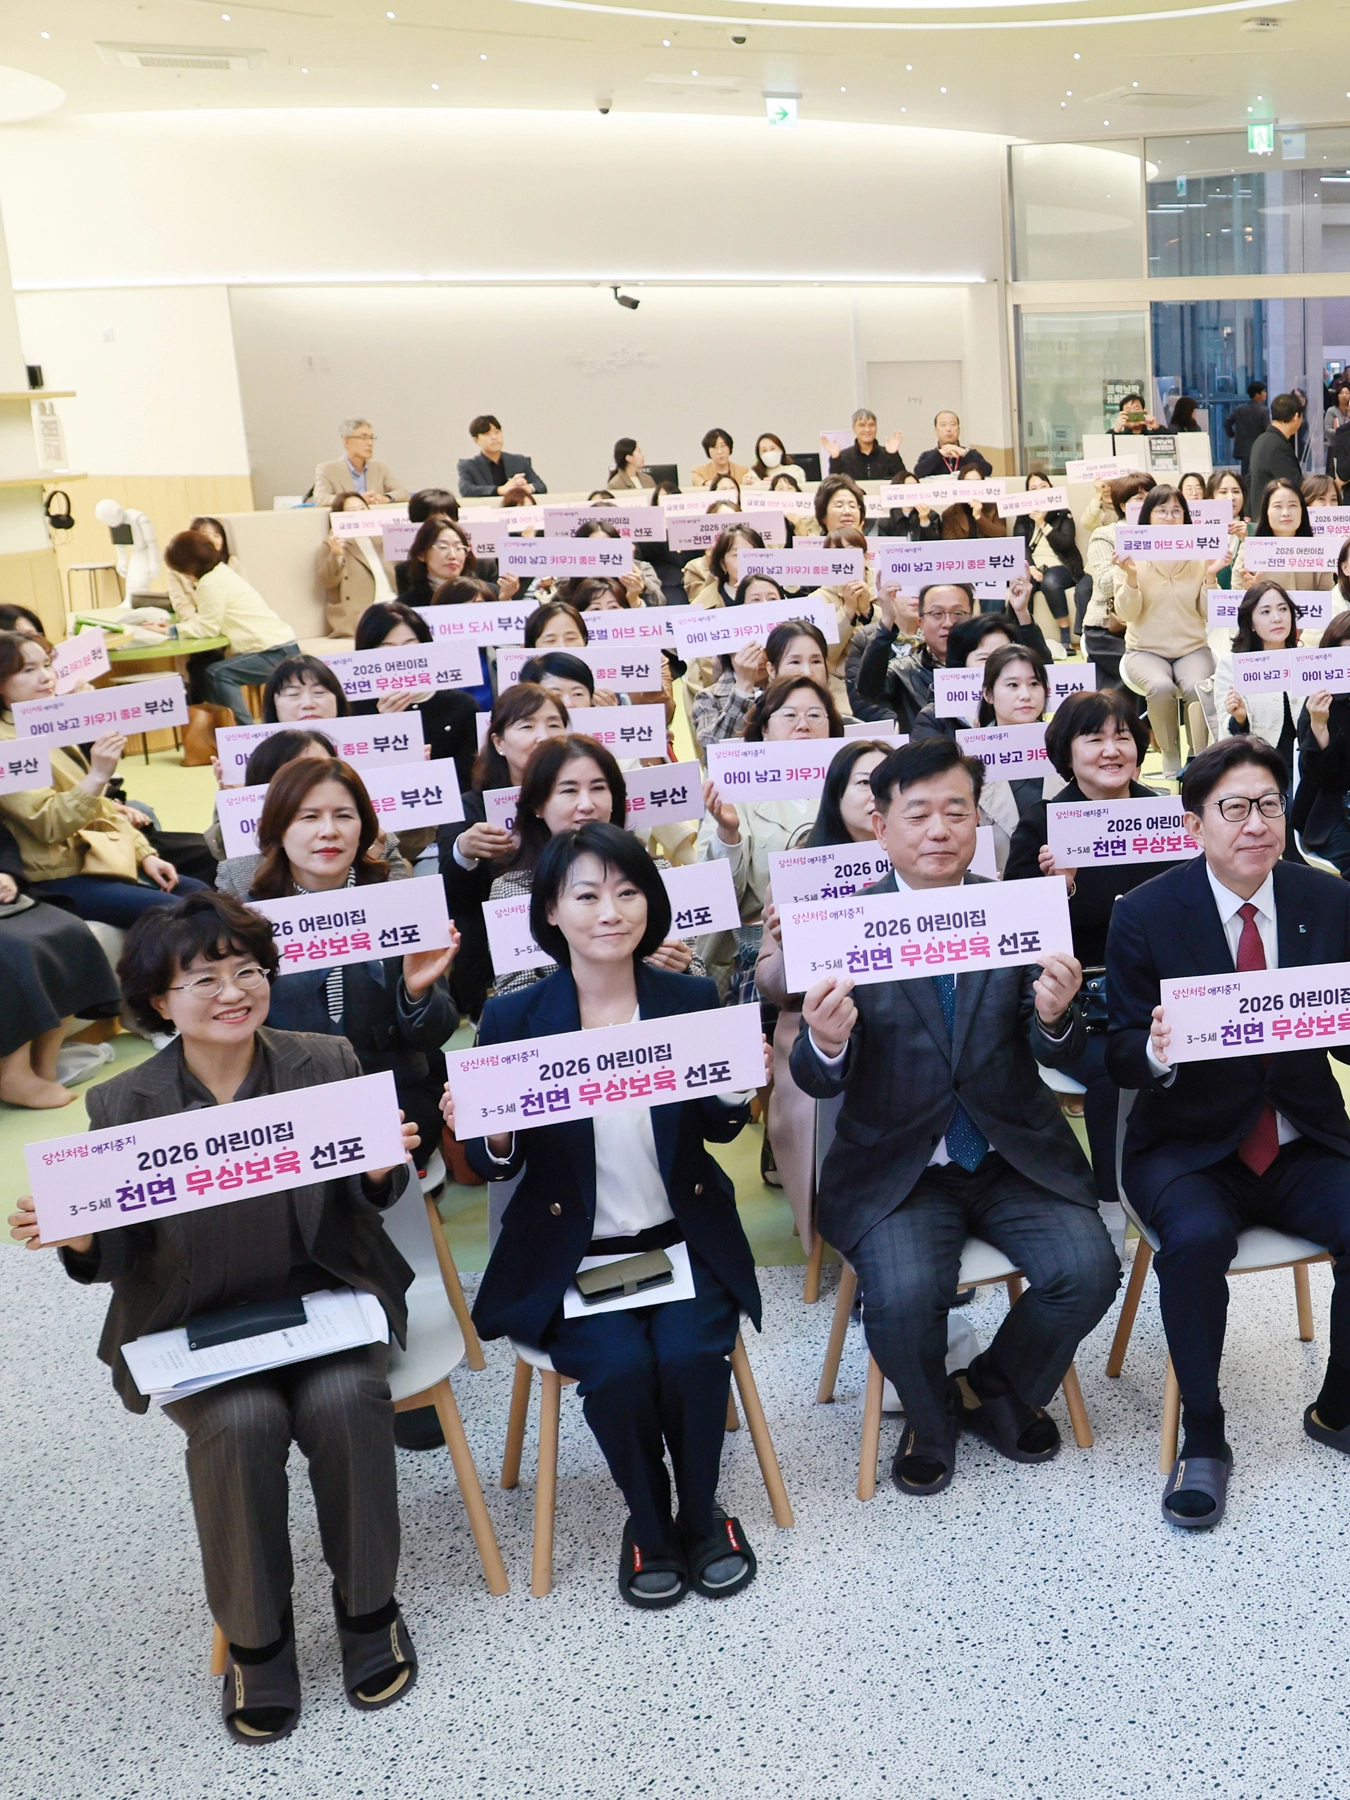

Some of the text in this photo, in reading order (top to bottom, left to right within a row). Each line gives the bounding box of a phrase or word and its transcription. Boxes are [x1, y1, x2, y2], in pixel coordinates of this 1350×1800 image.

[932, 489, 947, 498] 부산
[1123, 536, 1219, 551] 글로벌 허브 도시 부산
[509, 555, 526, 564] 아이
[550, 556, 577, 564] 키우기
[579, 556, 596, 564] 좋은
[599, 554, 623, 565] 부산
[891, 554, 1014, 572] 아이 낳고 키우기 좋은 부산
[353, 657, 428, 675] 2026 어린이집
[376, 669, 462, 690] 무상보육 선포
[31, 698, 173, 735] 아이 낳고 키우기 좋은 부산
[342, 734, 408, 755] 좋은 부산
[9, 758, 38, 776] 부산
[724, 767, 826, 785] 아이 낳고 키우기
[650, 786, 687, 807] 부산
[1108, 818, 1142, 832] 2026
[1067, 835, 1198, 857] 3~5세 전면 무상보육
[299, 910, 366, 933] 어린이집
[674, 906, 712, 929] 선포
[792, 907, 864, 924] 당신처럼 애지중지
[864, 910, 986, 939] 2026 어린이집
[284, 924, 420, 963] 무상보육 선포
[810, 931, 1041, 973] 3~5세 전면 무상보육 선포
[1173, 983, 1240, 999] 당신처럼 애지중지
[1239, 995, 1284, 1014] 2026
[1187, 1032, 1217, 1044] 3~5세
[1220, 1021, 1264, 1046] 전면
[460, 1049, 539, 1072] 당신처럼 애지중지
[540, 1043, 671, 1081] 2026 어린이집
[481, 1061, 731, 1117] 3~5세 전면 무상보육 선포
[42, 1136, 136, 1165] 당신처럼 애지중지
[137, 1122, 294, 1170] 2026 어린이집
[69, 1137, 365, 1216] 3~5세 전면 무상보육 선포
